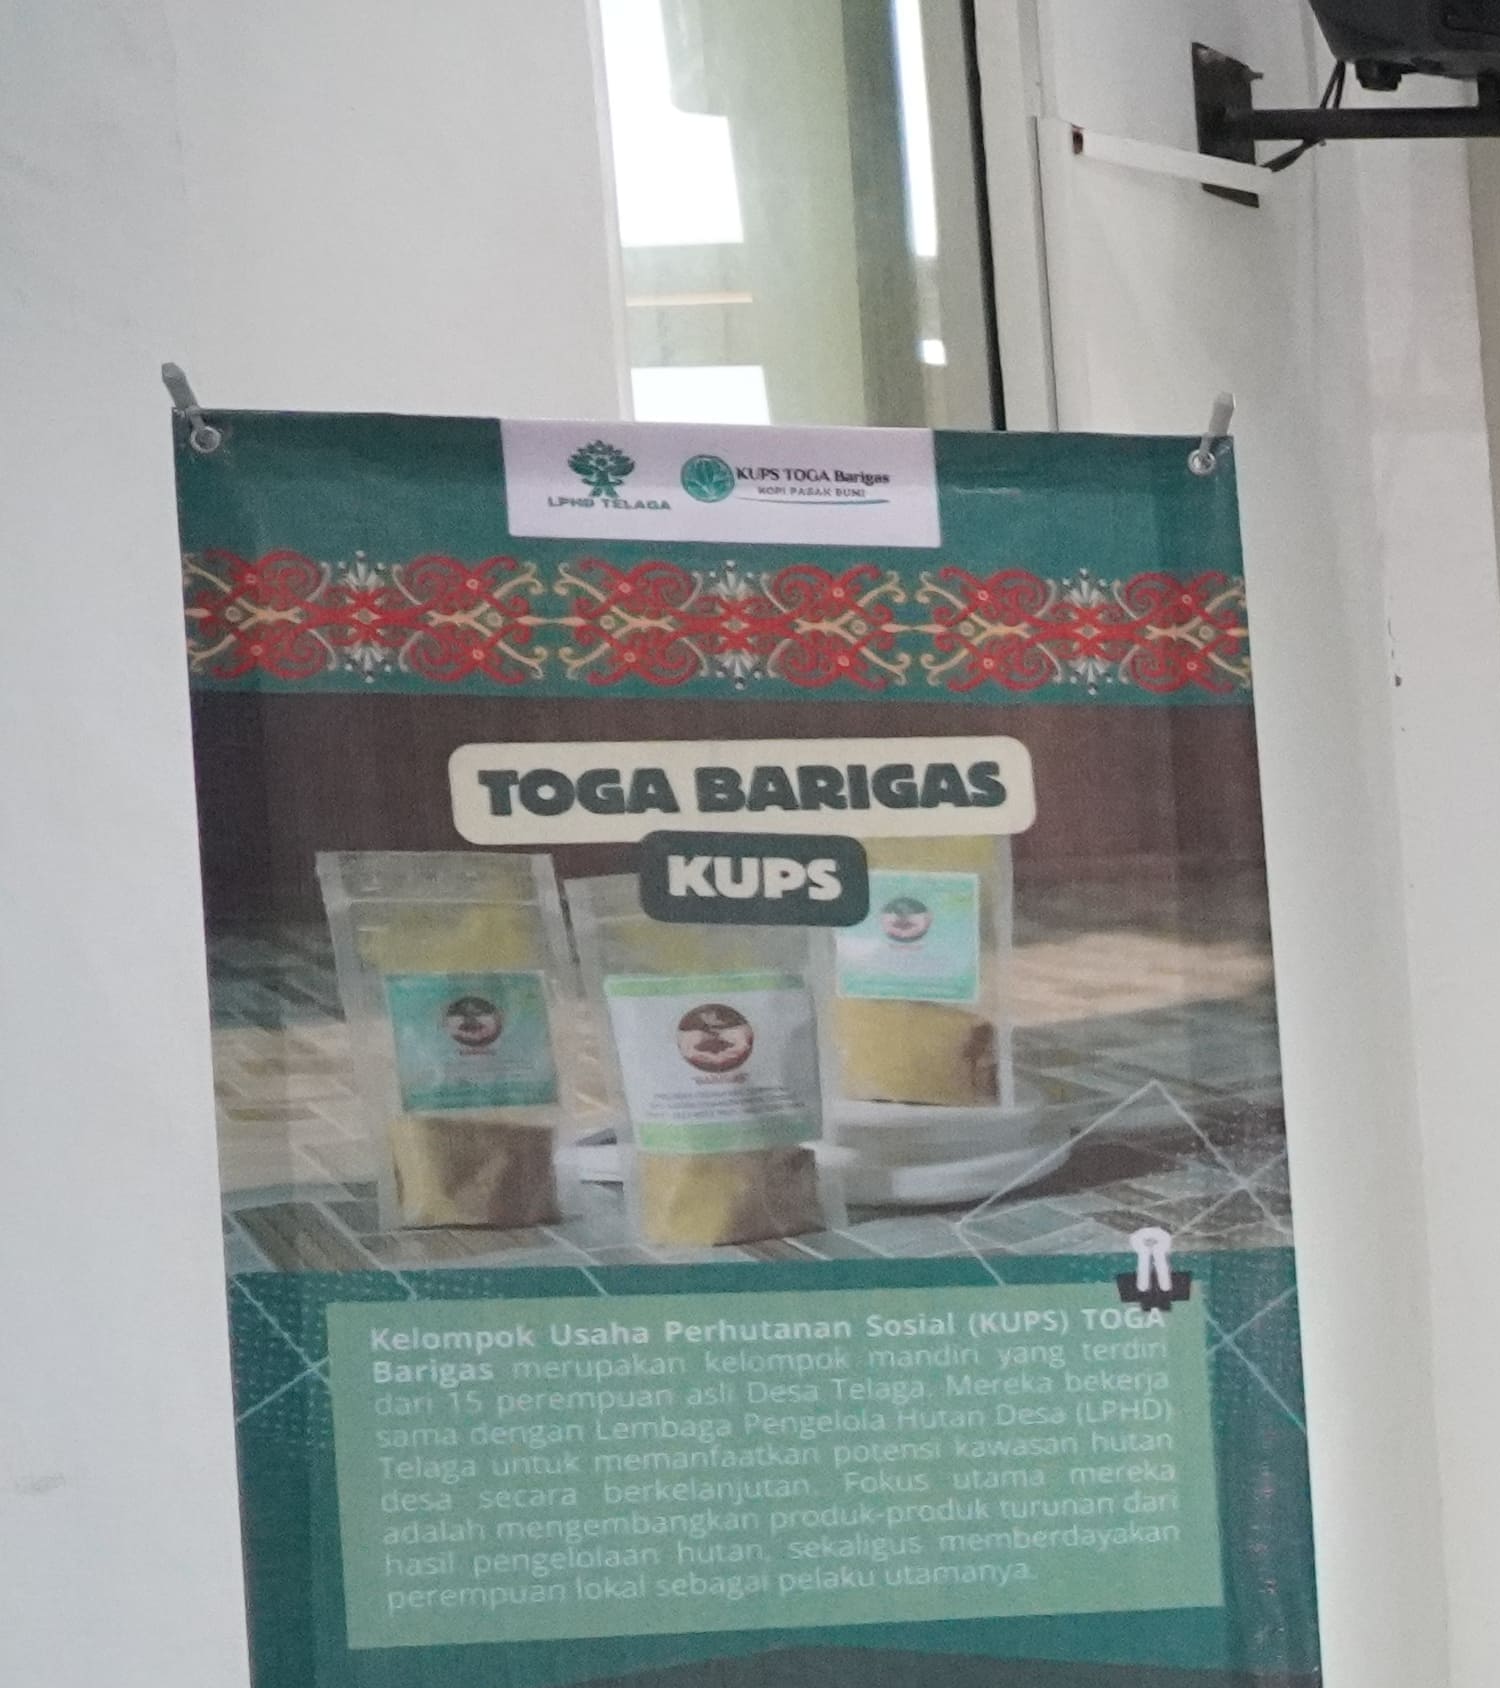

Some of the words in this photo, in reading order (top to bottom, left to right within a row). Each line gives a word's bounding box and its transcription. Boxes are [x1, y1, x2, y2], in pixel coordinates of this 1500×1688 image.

[736, 466, 780, 481] KUPS
[784, 468, 829, 482] TOGA
[833, 470, 890, 486] Barigas
[603, 498, 671, 510] TELAGA
[478, 767, 676, 816] TOGA
[696, 761, 1006, 814] BARIGAS
[667, 852, 842, 901] KUPS
[371, 1325, 535, 1354] Kelompok
[550, 1322, 648, 1346] Usaha
[665, 1317, 852, 1344] Perhutanan
[866, 1312, 955, 1337] Sosial
[968, 1310, 1069, 1337] (KUPS)
[1081, 1308, 1166, 1329] TOGA
[373, 1359, 494, 1388] Barigas
[512, 1354, 685, 1382] merupakan
[704, 1347, 850, 1377] kelompok
[868, 1343, 979, 1368] mandiri
[999, 1343, 1065, 1369] yang
[1082, 1338, 1168, 1361] terdiri
[375, 1393, 432, 1416] dari
[451, 1390, 482, 1415] 15
[498, 1387, 673, 1418] perempuan
[687, 1381, 734, 1406] asli
[746, 1381, 819, 1403] Desa
[945, 1373, 1053, 1397] Mereka
[1065, 1370, 1169, 1395] bekerja
[375, 1426, 457, 1448] sama
[470, 1423, 583, 1450] dengan
[597, 1417, 732, 1443] Lembaga
[744, 1411, 885, 1440] Pengelola
[898, 1409, 984, 1429] Hutan
[997, 1404, 1066, 1426] Desa
[1076, 1399, 1173, 1425] (LPHD)
[379, 1456, 476, 1485] Telaga
[493, 1453, 580, 1476] untuk
[594, 1443, 819, 1474] memanfaatkan
[834, 1442, 942, 1468] potensi
[955, 1435, 1079, 1459] kawasan
[1092, 1432, 1173, 1452] hutan
[381, 1491, 451, 1512] desa
[479, 1485, 577, 1508] secara
[845, 1472, 929, 1494] Fokus
[953, 1468, 1045, 1489] utama
[1070, 1461, 1175, 1484] mereka
[383, 1519, 485, 1544] adalah
[497, 1508, 759, 1544] mengembangkan
[771, 1500, 989, 1535] produk-produk
[1000, 1494, 1114, 1517] turunan
[1123, 1490, 1178, 1514] dari
[385, 1552, 455, 1577] hasil
[474, 1546, 658, 1578] pengelolaan
[788, 1535, 922, 1561] sekaligus
[940, 1523, 1180, 1551] memberdayakan
[388, 1584, 566, 1615] perempuan
[578, 1575, 646, 1601] lokal
[656, 1571, 768, 1600] sebagai
[779, 1567, 875, 1596] pelaku
